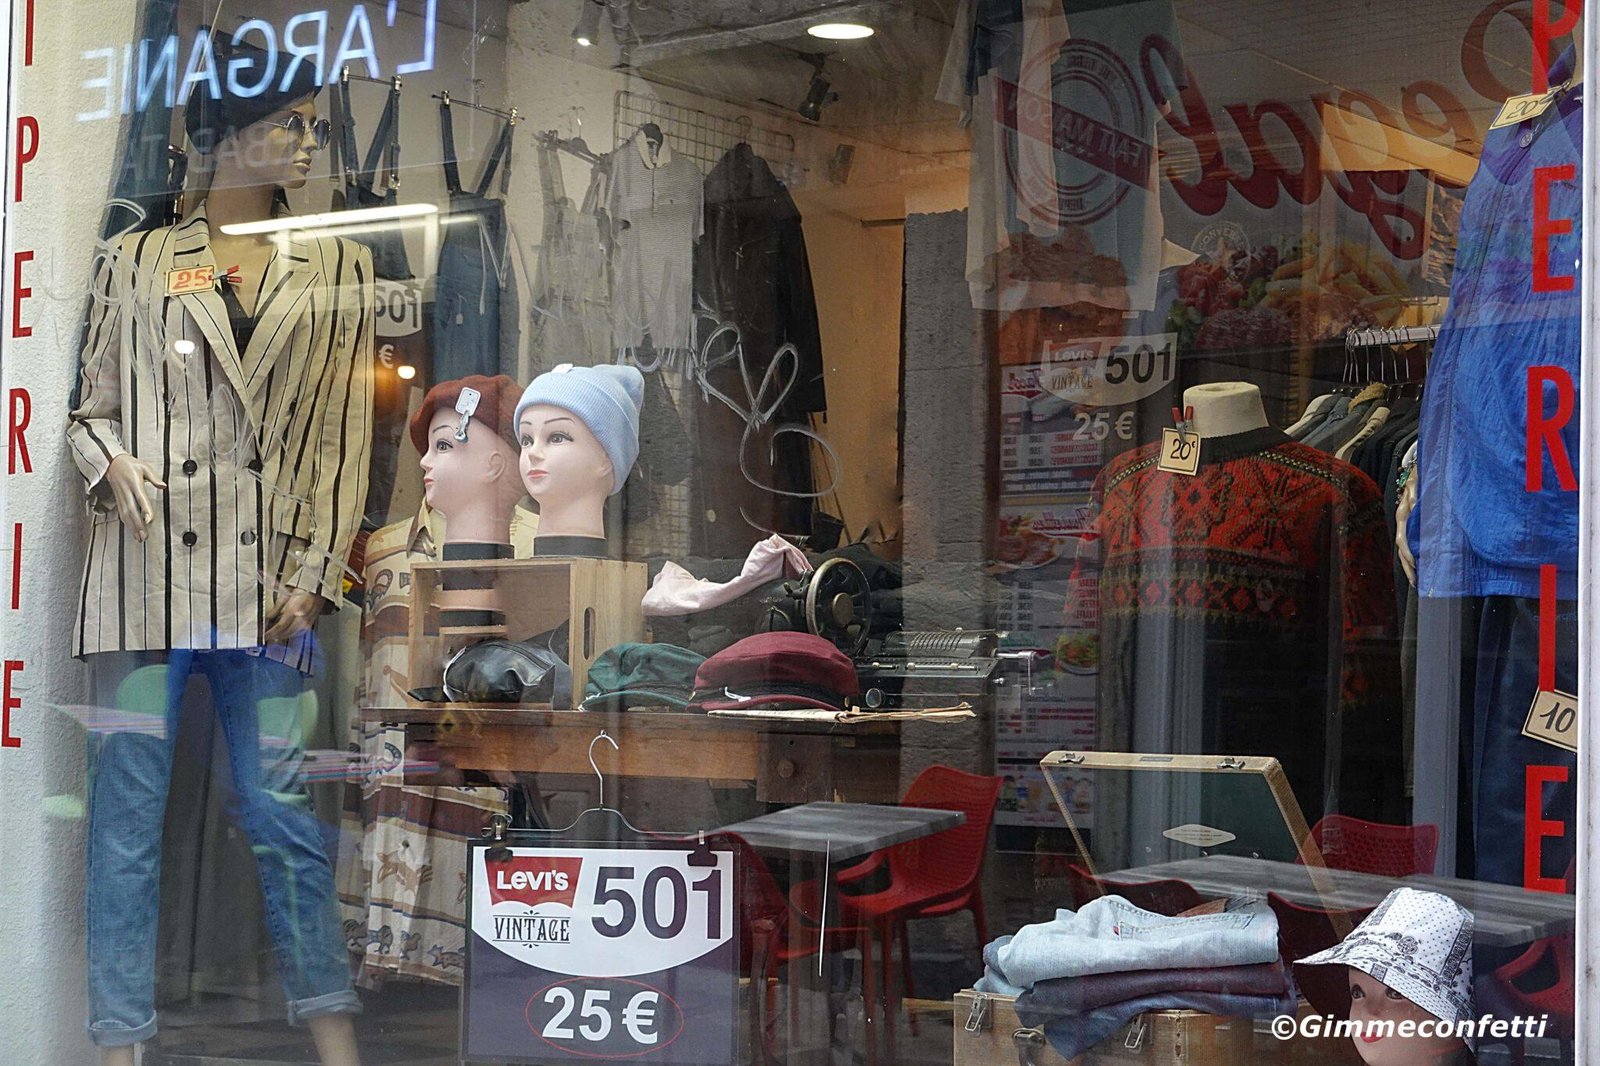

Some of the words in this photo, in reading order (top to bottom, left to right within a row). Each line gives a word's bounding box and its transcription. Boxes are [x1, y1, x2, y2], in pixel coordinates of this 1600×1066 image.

[1105, 343, 1171, 384] 501
[1072, 412, 1110, 441] 25
[1114, 411, 1136, 440] €
[591, 866, 722, 940] 501
[494, 915, 571, 942] VINTAGE
[542, 987, 612, 1044] 25
[622, 990, 660, 1045] €
